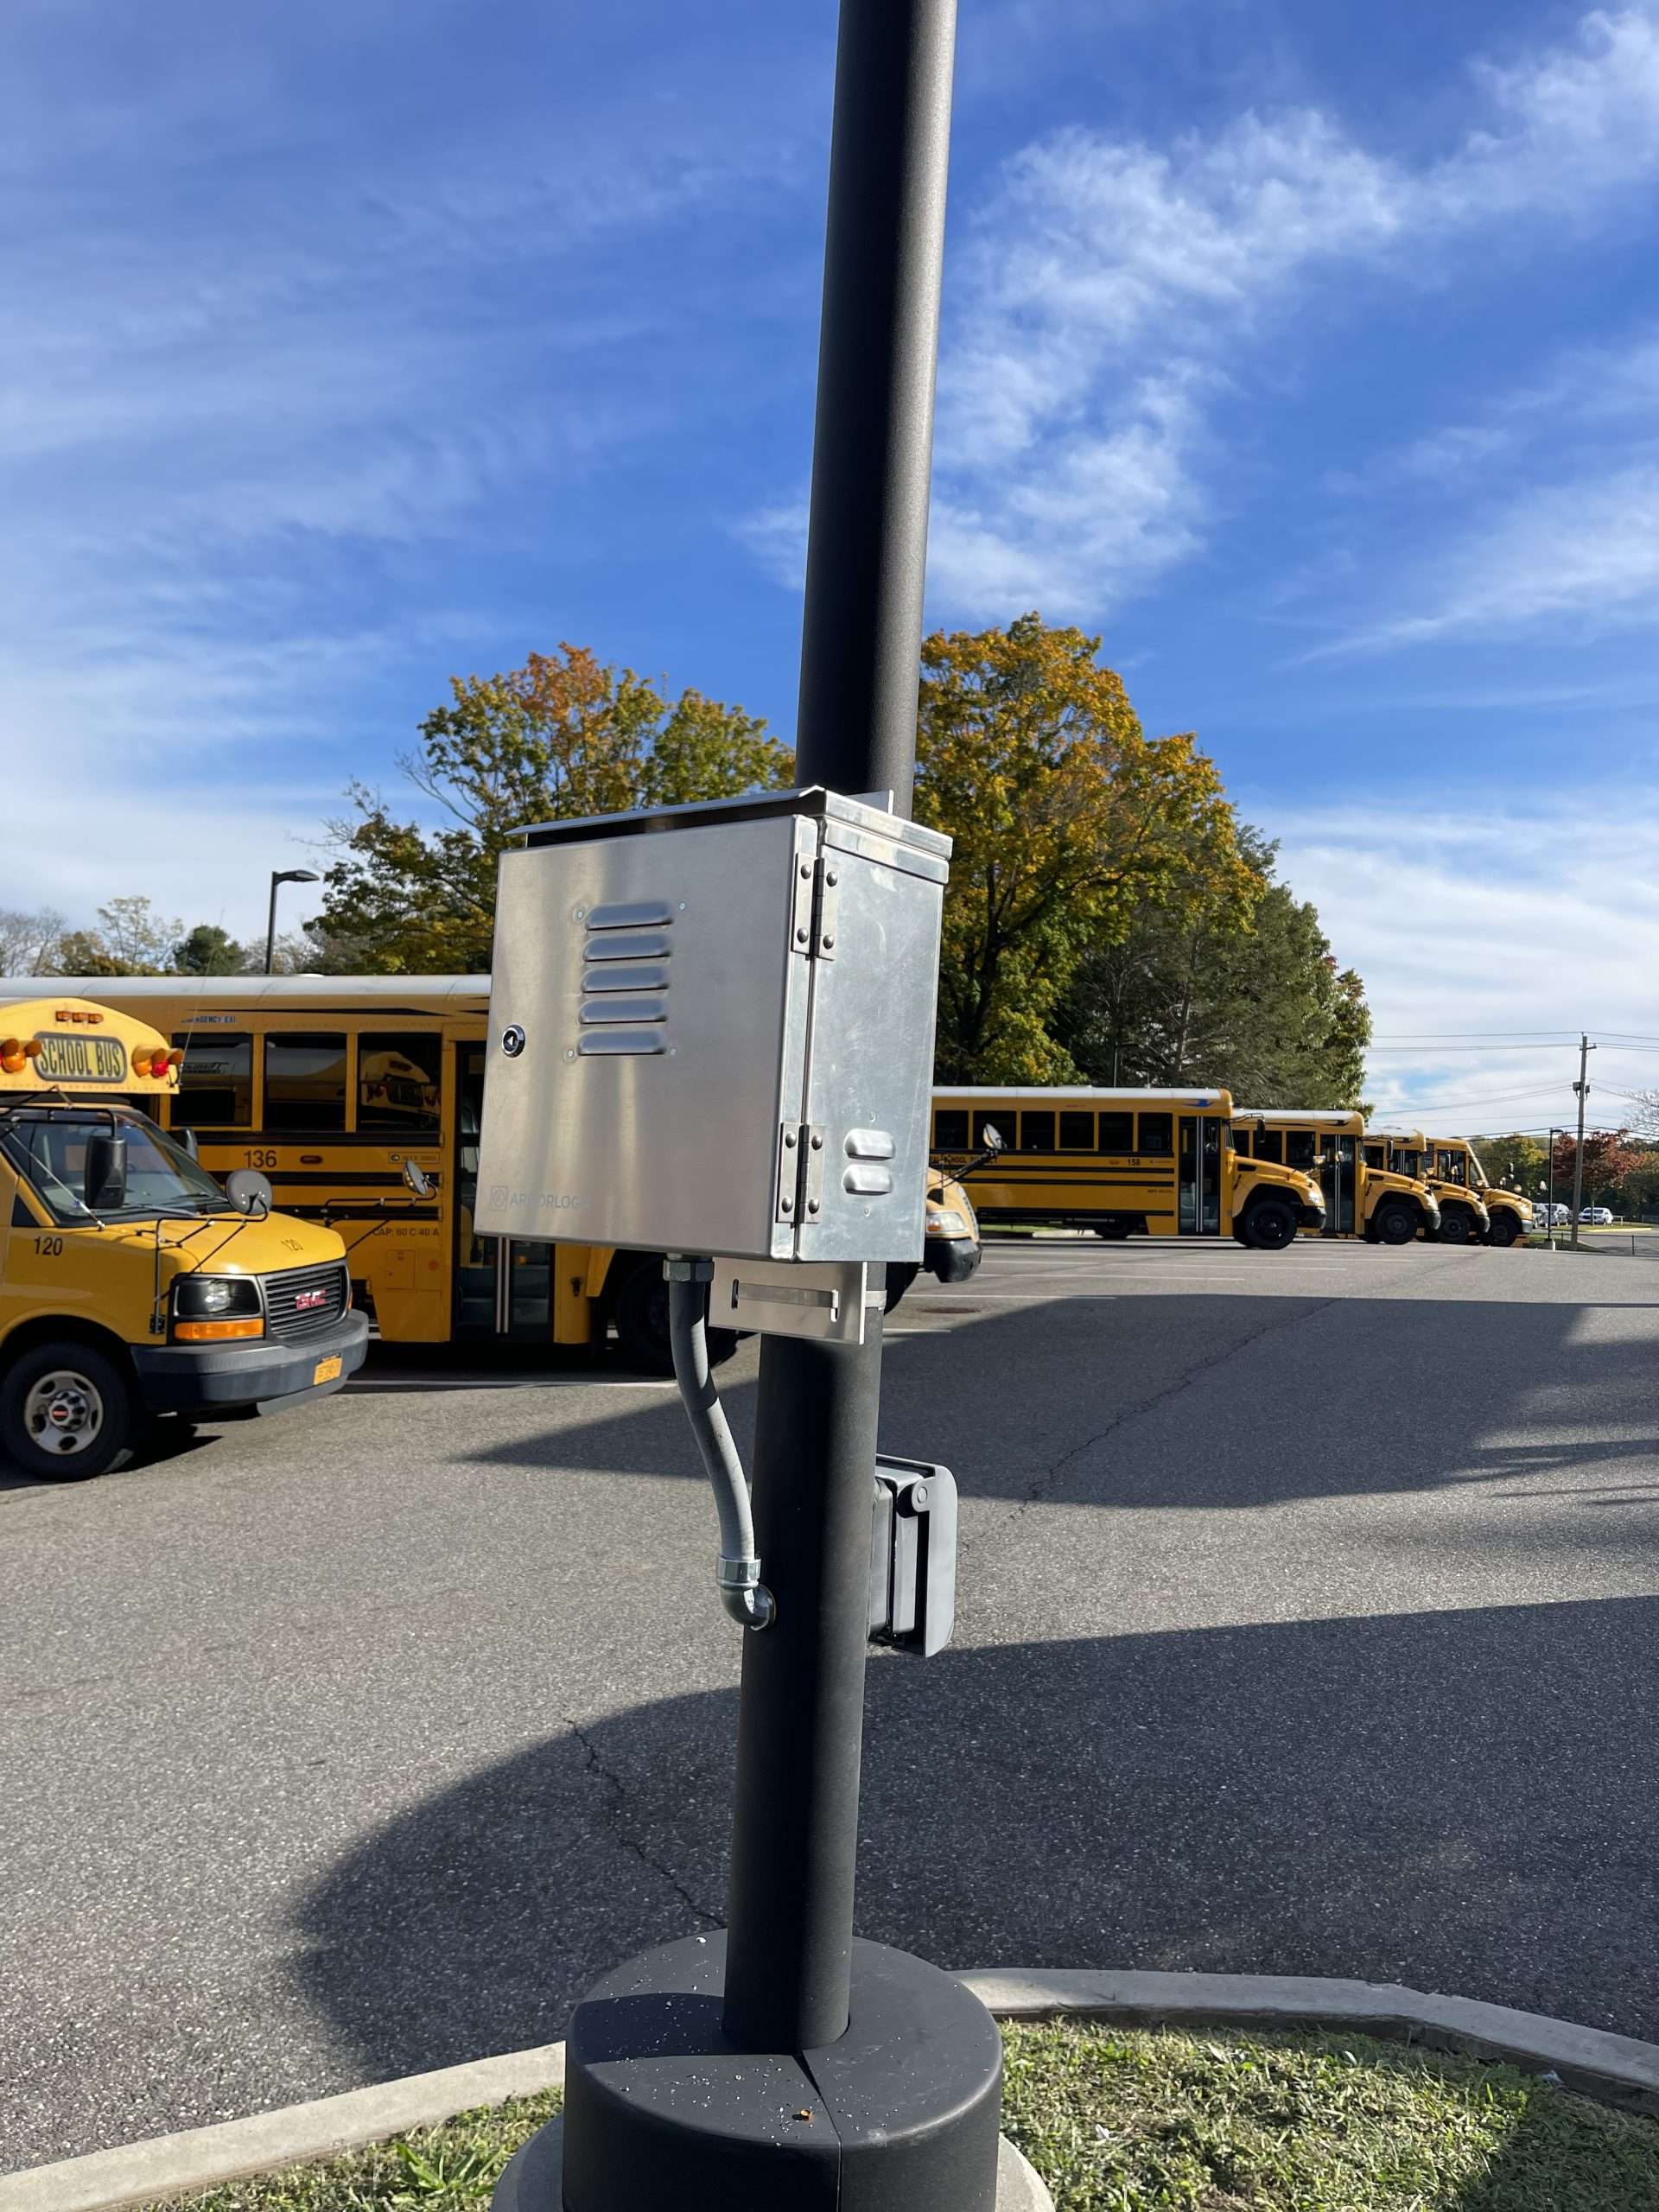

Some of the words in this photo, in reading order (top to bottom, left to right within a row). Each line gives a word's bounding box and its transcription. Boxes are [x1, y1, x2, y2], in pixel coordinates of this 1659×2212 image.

[40, 1037, 92, 1074] SCHOOL
[96, 1042, 122, 1077] BUS
[244, 1149, 277, 1168] 136
[1127, 1158, 1141, 1166] 158
[35, 1236, 63, 1256] 120
